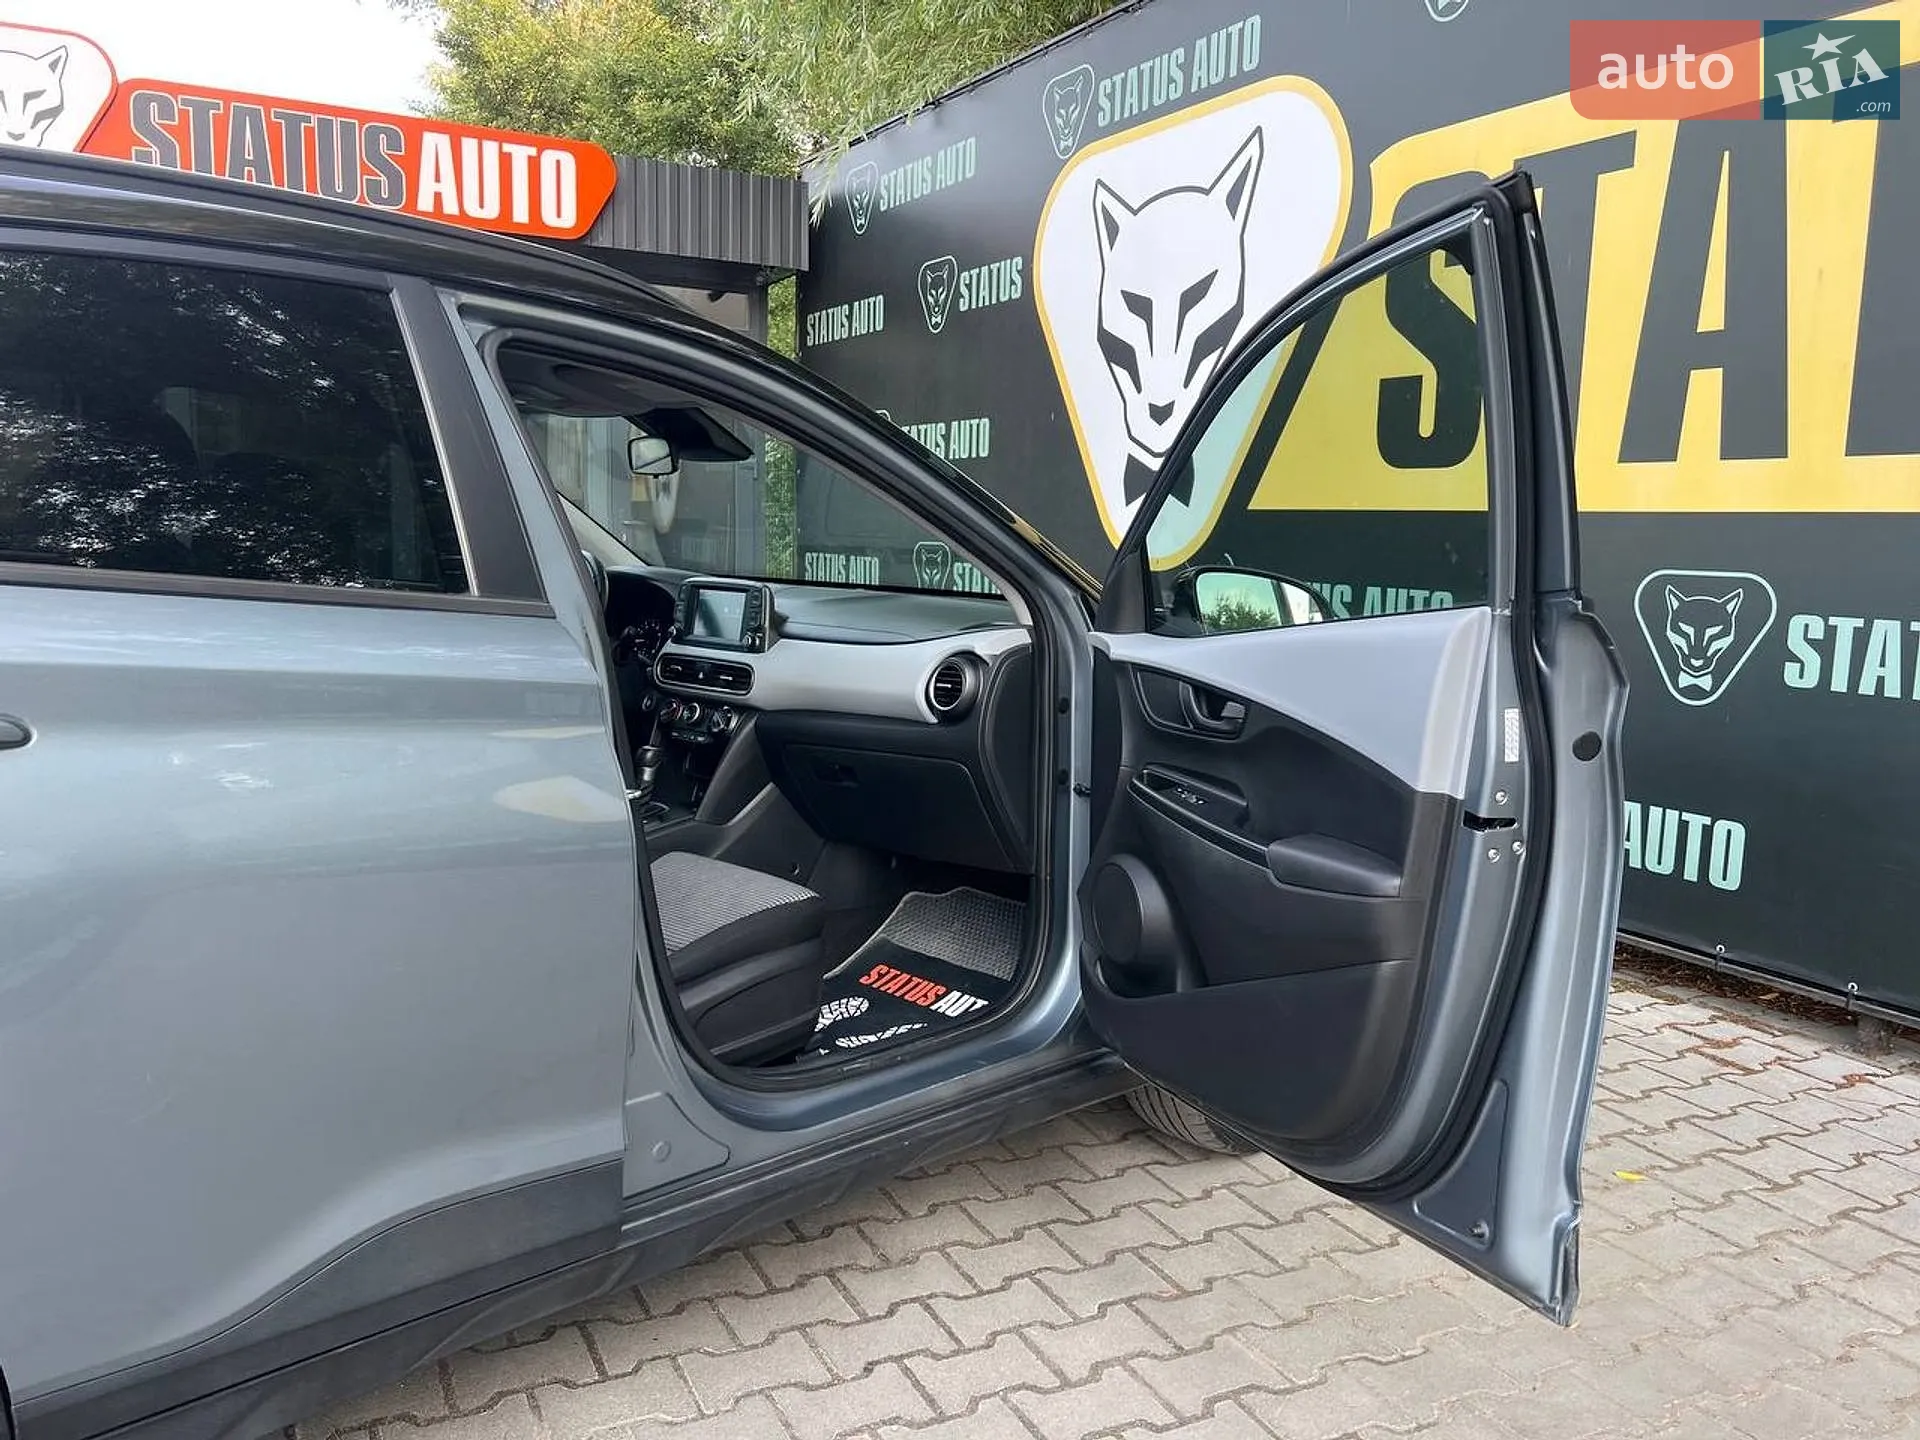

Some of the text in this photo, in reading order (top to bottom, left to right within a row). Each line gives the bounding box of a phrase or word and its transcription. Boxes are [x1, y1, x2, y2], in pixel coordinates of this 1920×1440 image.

[1098, 14, 1261, 127] STATUS AUTO
[129, 91, 578, 229] STATUS AUTO
[880, 136, 976, 212] STATUS AUTO
[959, 256, 1023, 312] STATUS
[806, 294, 884, 346] STATUS AUTO
[949, 417, 989, 459] AUTO
[805, 552, 879, 585] STATUS AUTO
[1784, 614, 1920, 701] STA
[1624, 800, 1746, 891] AUTO
[859, 964, 947, 1007] STATUS
